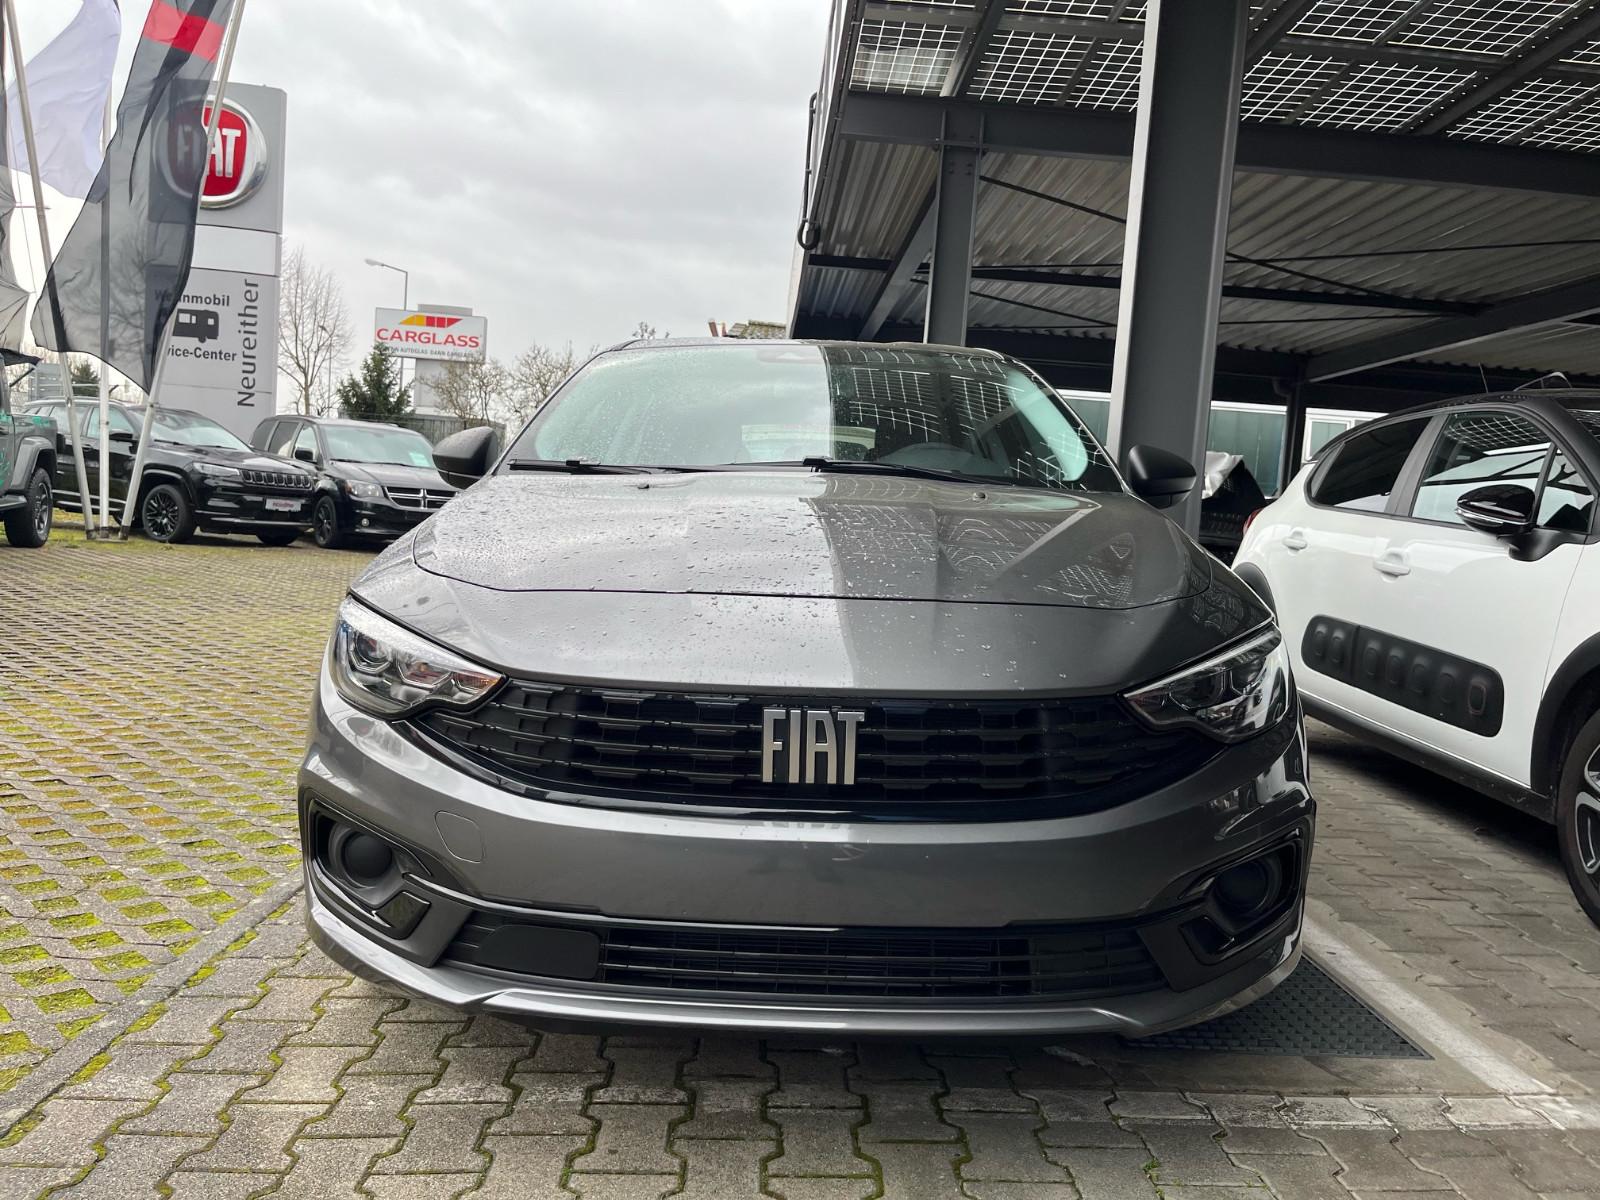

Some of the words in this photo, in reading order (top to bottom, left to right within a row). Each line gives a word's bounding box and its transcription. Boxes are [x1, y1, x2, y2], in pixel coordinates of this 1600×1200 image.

[237, 278, 259, 407] Neureither
[376, 328, 480, 349] CARGLASS
[762, 708, 865, 785] FIAT
